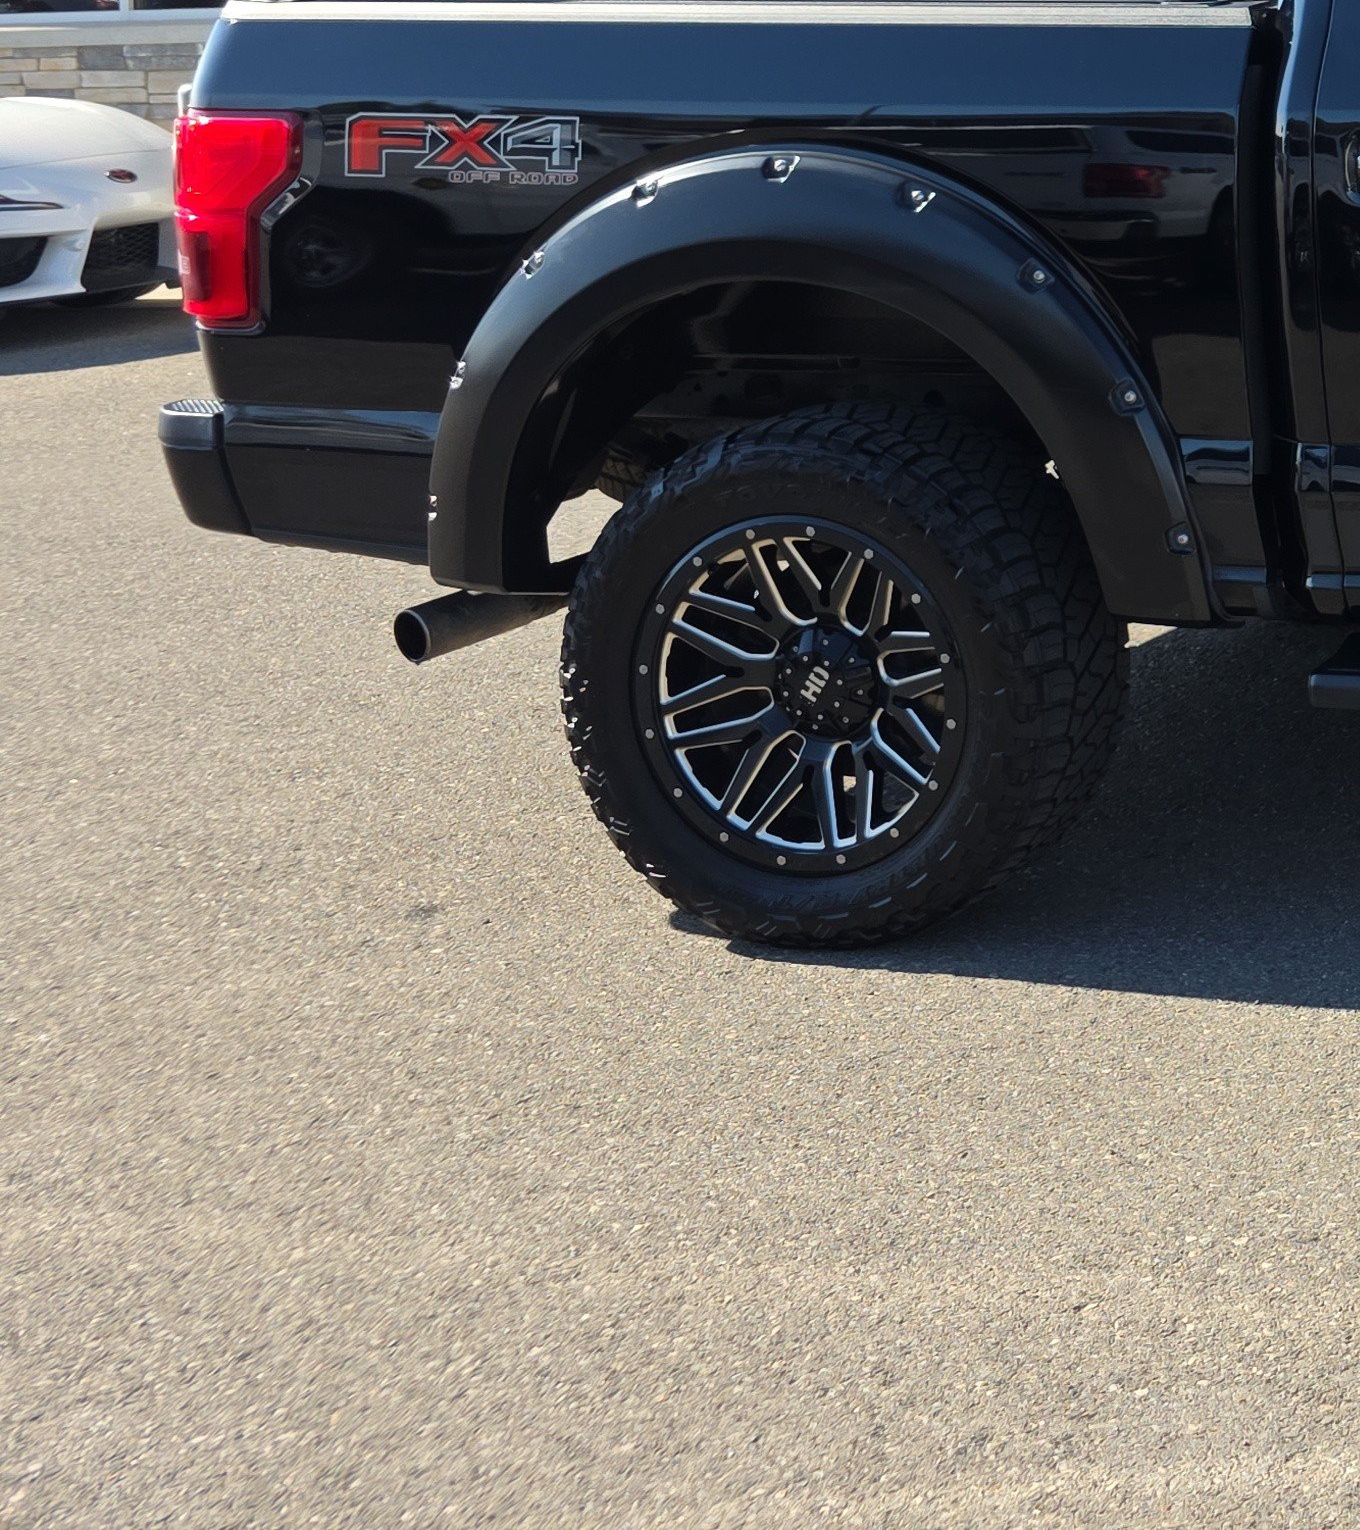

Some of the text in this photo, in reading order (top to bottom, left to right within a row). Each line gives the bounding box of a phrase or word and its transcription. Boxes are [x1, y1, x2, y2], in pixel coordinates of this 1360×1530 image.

[345, 112, 582, 177] FX4
[450, 171, 579, 185] OFF ROAD
[800, 665, 831, 704] HD
